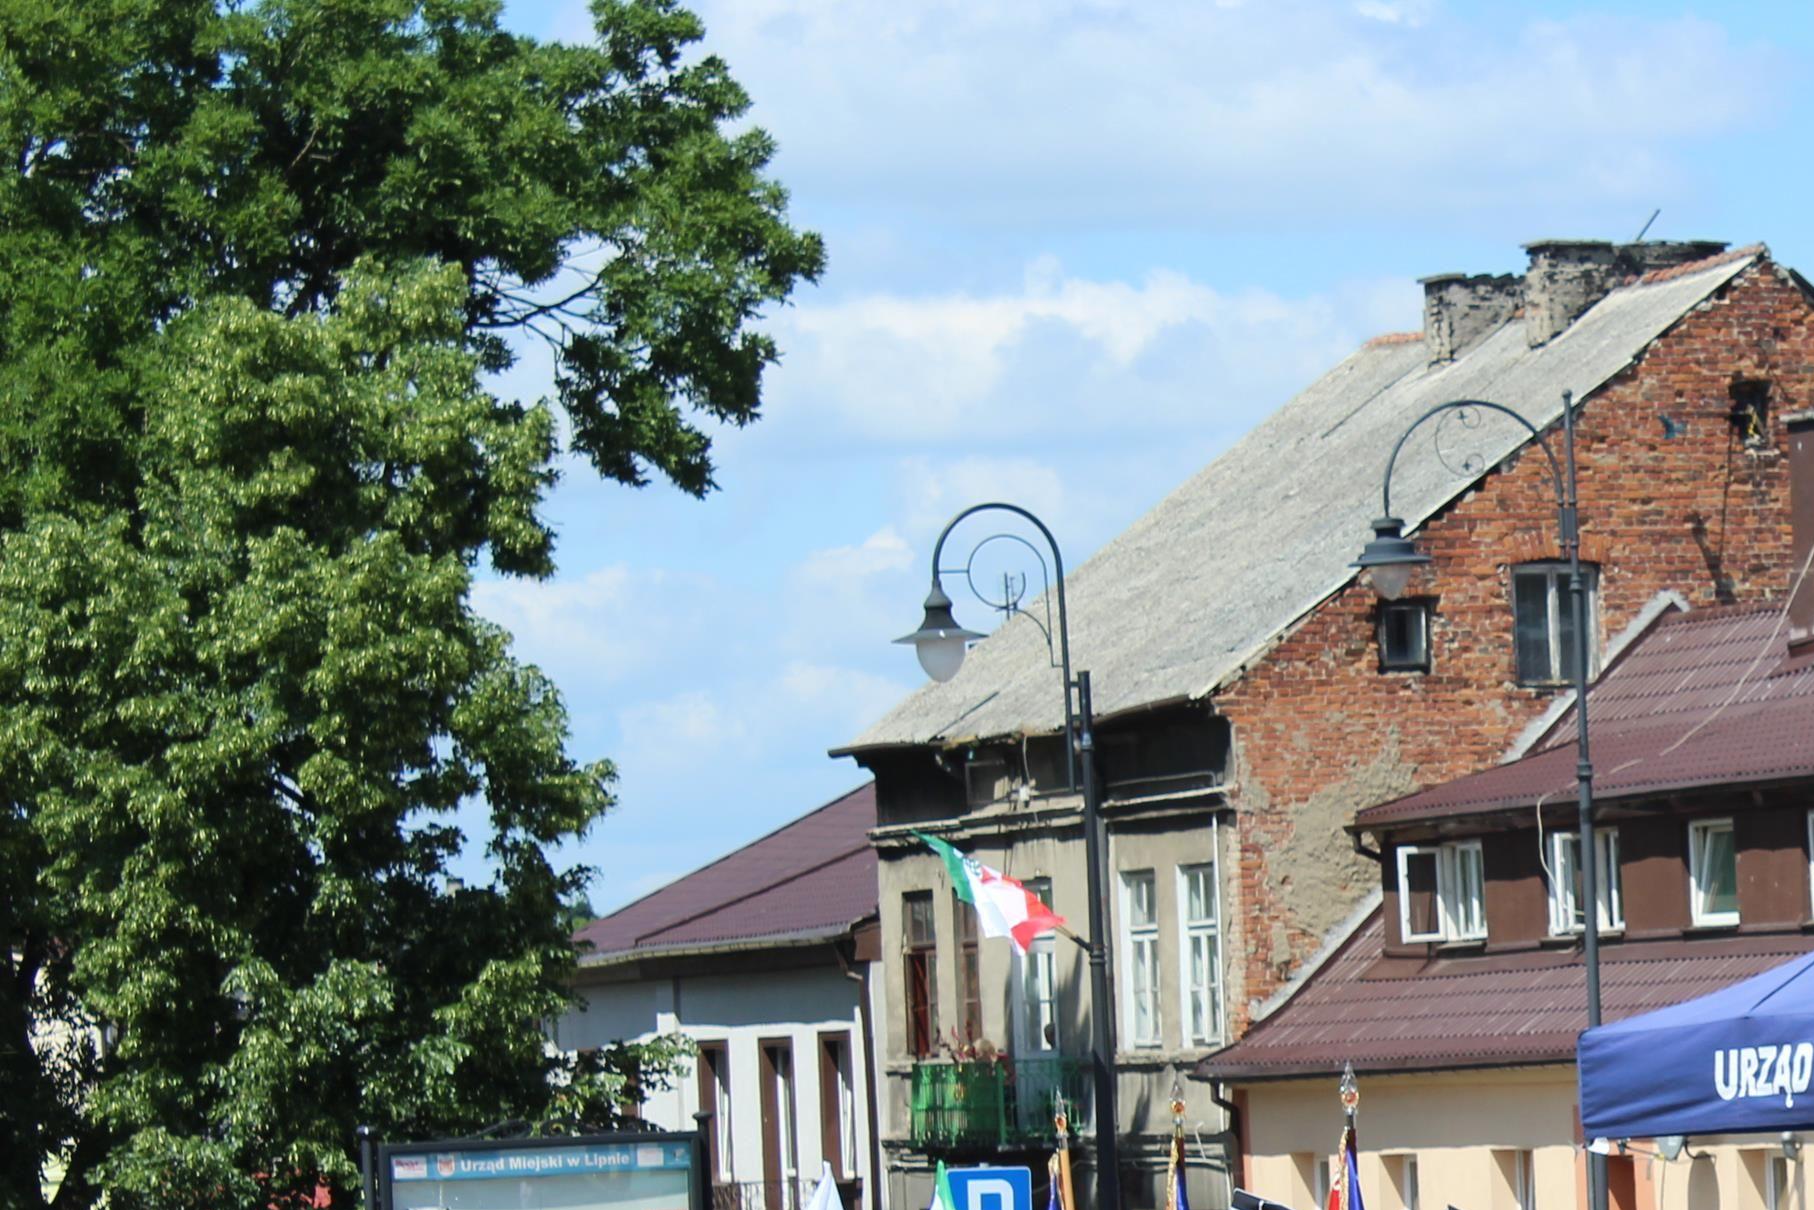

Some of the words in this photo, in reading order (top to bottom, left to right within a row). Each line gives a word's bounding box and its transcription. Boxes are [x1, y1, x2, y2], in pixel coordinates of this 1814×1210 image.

[1714, 1042, 1813, 1108] URZĄD
[460, 1157, 504, 1175] Urząd
[508, 1155, 563, 1172] Miejski
[566, 1157, 581, 1167] w
[584, 1152, 630, 1169] Lipnie
